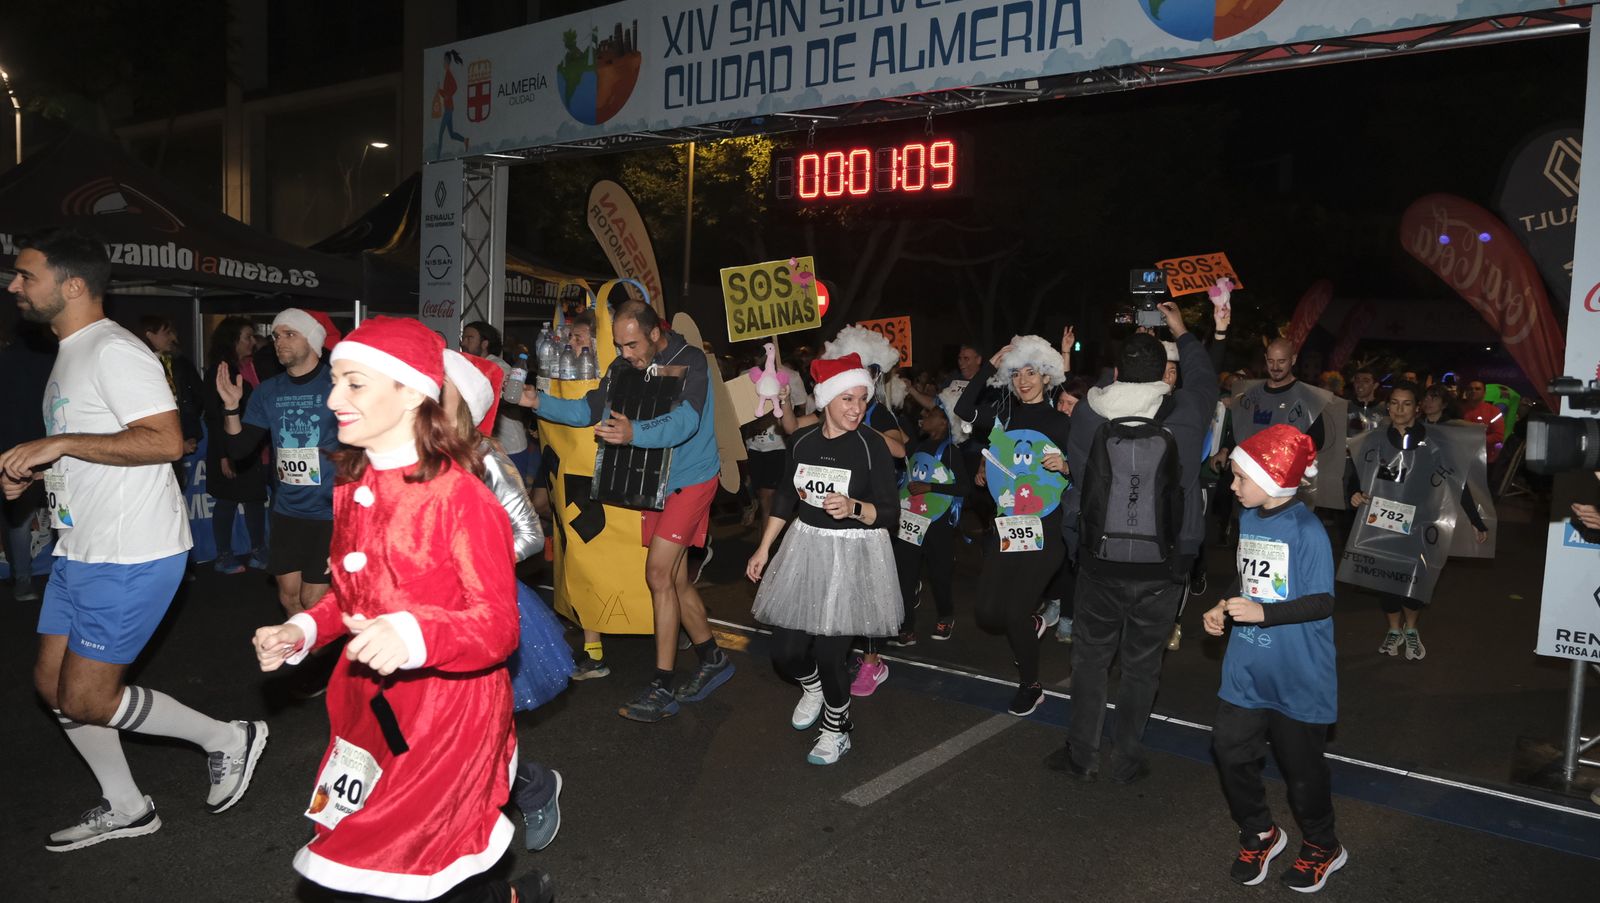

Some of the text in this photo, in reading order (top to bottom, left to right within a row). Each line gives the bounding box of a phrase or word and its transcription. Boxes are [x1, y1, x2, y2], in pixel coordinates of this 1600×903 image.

[662, 4, 719, 58] XIV
[730, 0, 806, 46] SAN
[664, 45, 793, 110] CIUDAD
[805, 32, 857, 88] DE
[497, 73, 548, 97] ALMERÍA
[508, 93, 535, 106] CIUDAD
[425, 213, 455, 222] RENAULT
[425, 258, 452, 266] NISSAN
[1162, 258, 1213, 277] SOS
[728, 266, 793, 305] SOS
[422, 300, 456, 318] Coca-Cola
[733, 297, 816, 335] SALINAS
[281, 460, 307, 473] 300
[805, 480, 835, 494] 404
[1380, 508, 1404, 522] 782
[901, 520, 921, 534] 362
[1008, 527, 1034, 539] 395
[1242, 557, 1270, 578] 712
[1555, 644, 1588, 657] SYRSA
